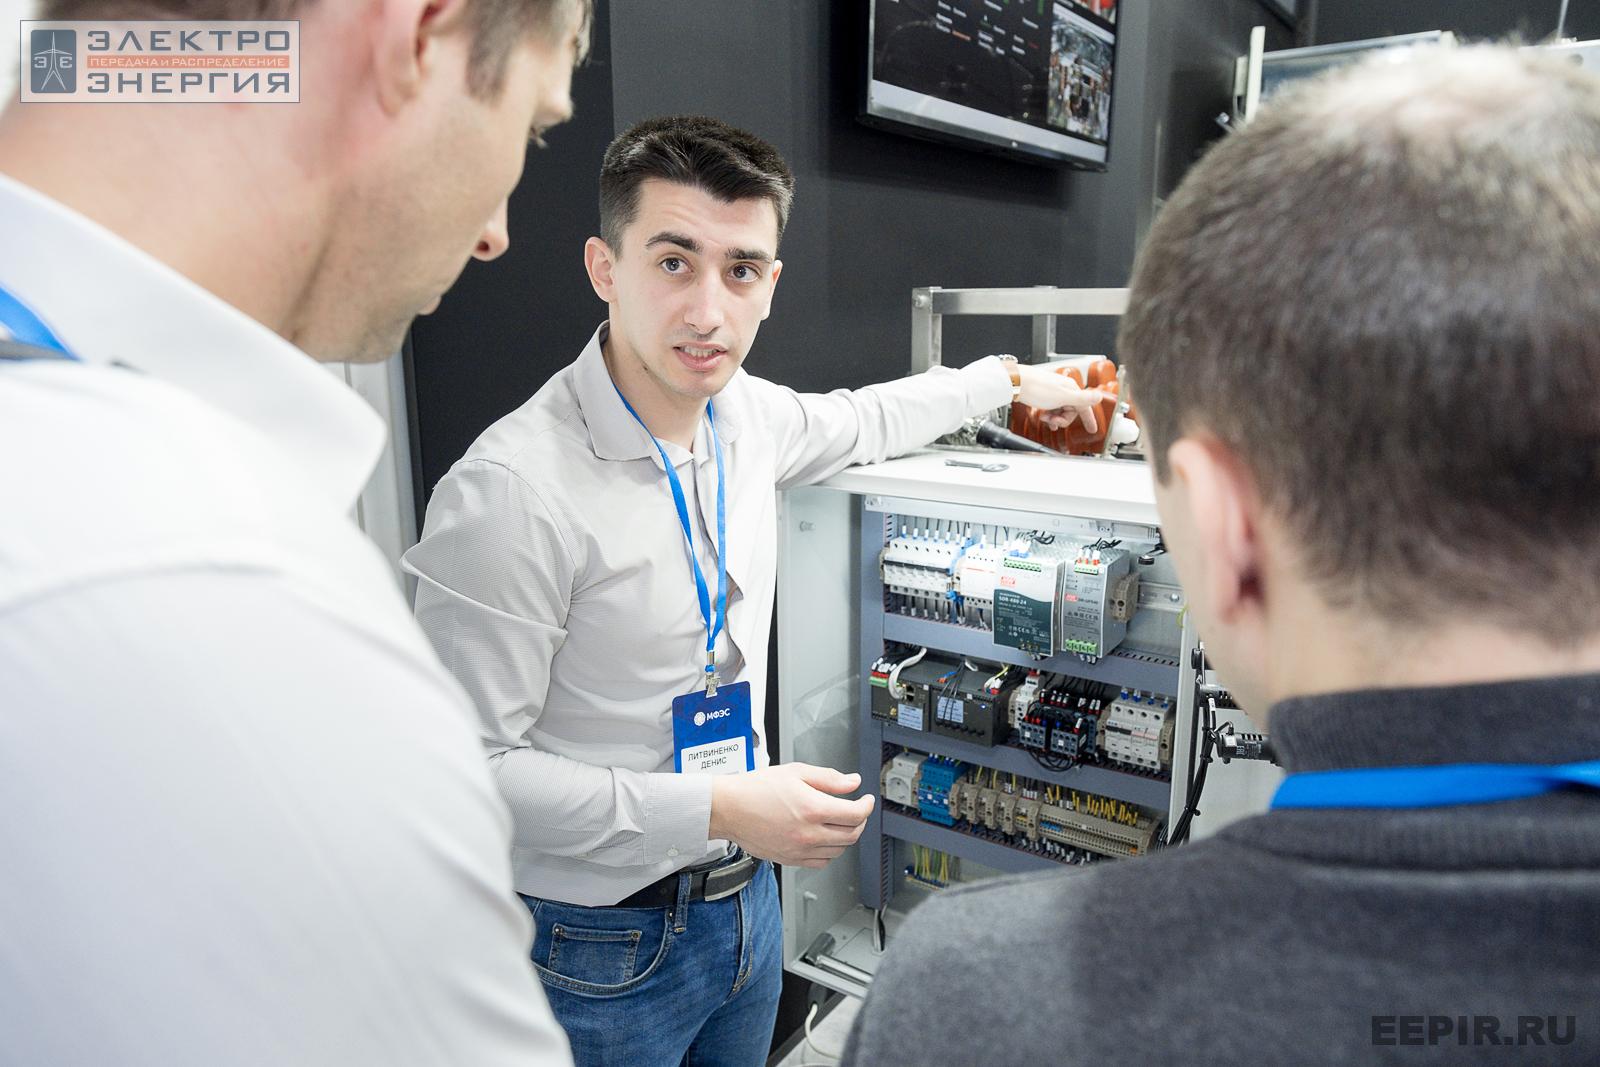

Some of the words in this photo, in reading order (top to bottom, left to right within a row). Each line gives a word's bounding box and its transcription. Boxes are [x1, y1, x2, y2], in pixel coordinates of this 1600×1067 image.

[706, 708, 730, 720] МФЭС
[688, 744, 739, 761] ЛИТВИНЕНКО
[701, 757, 727, 770] ДЕНИС
